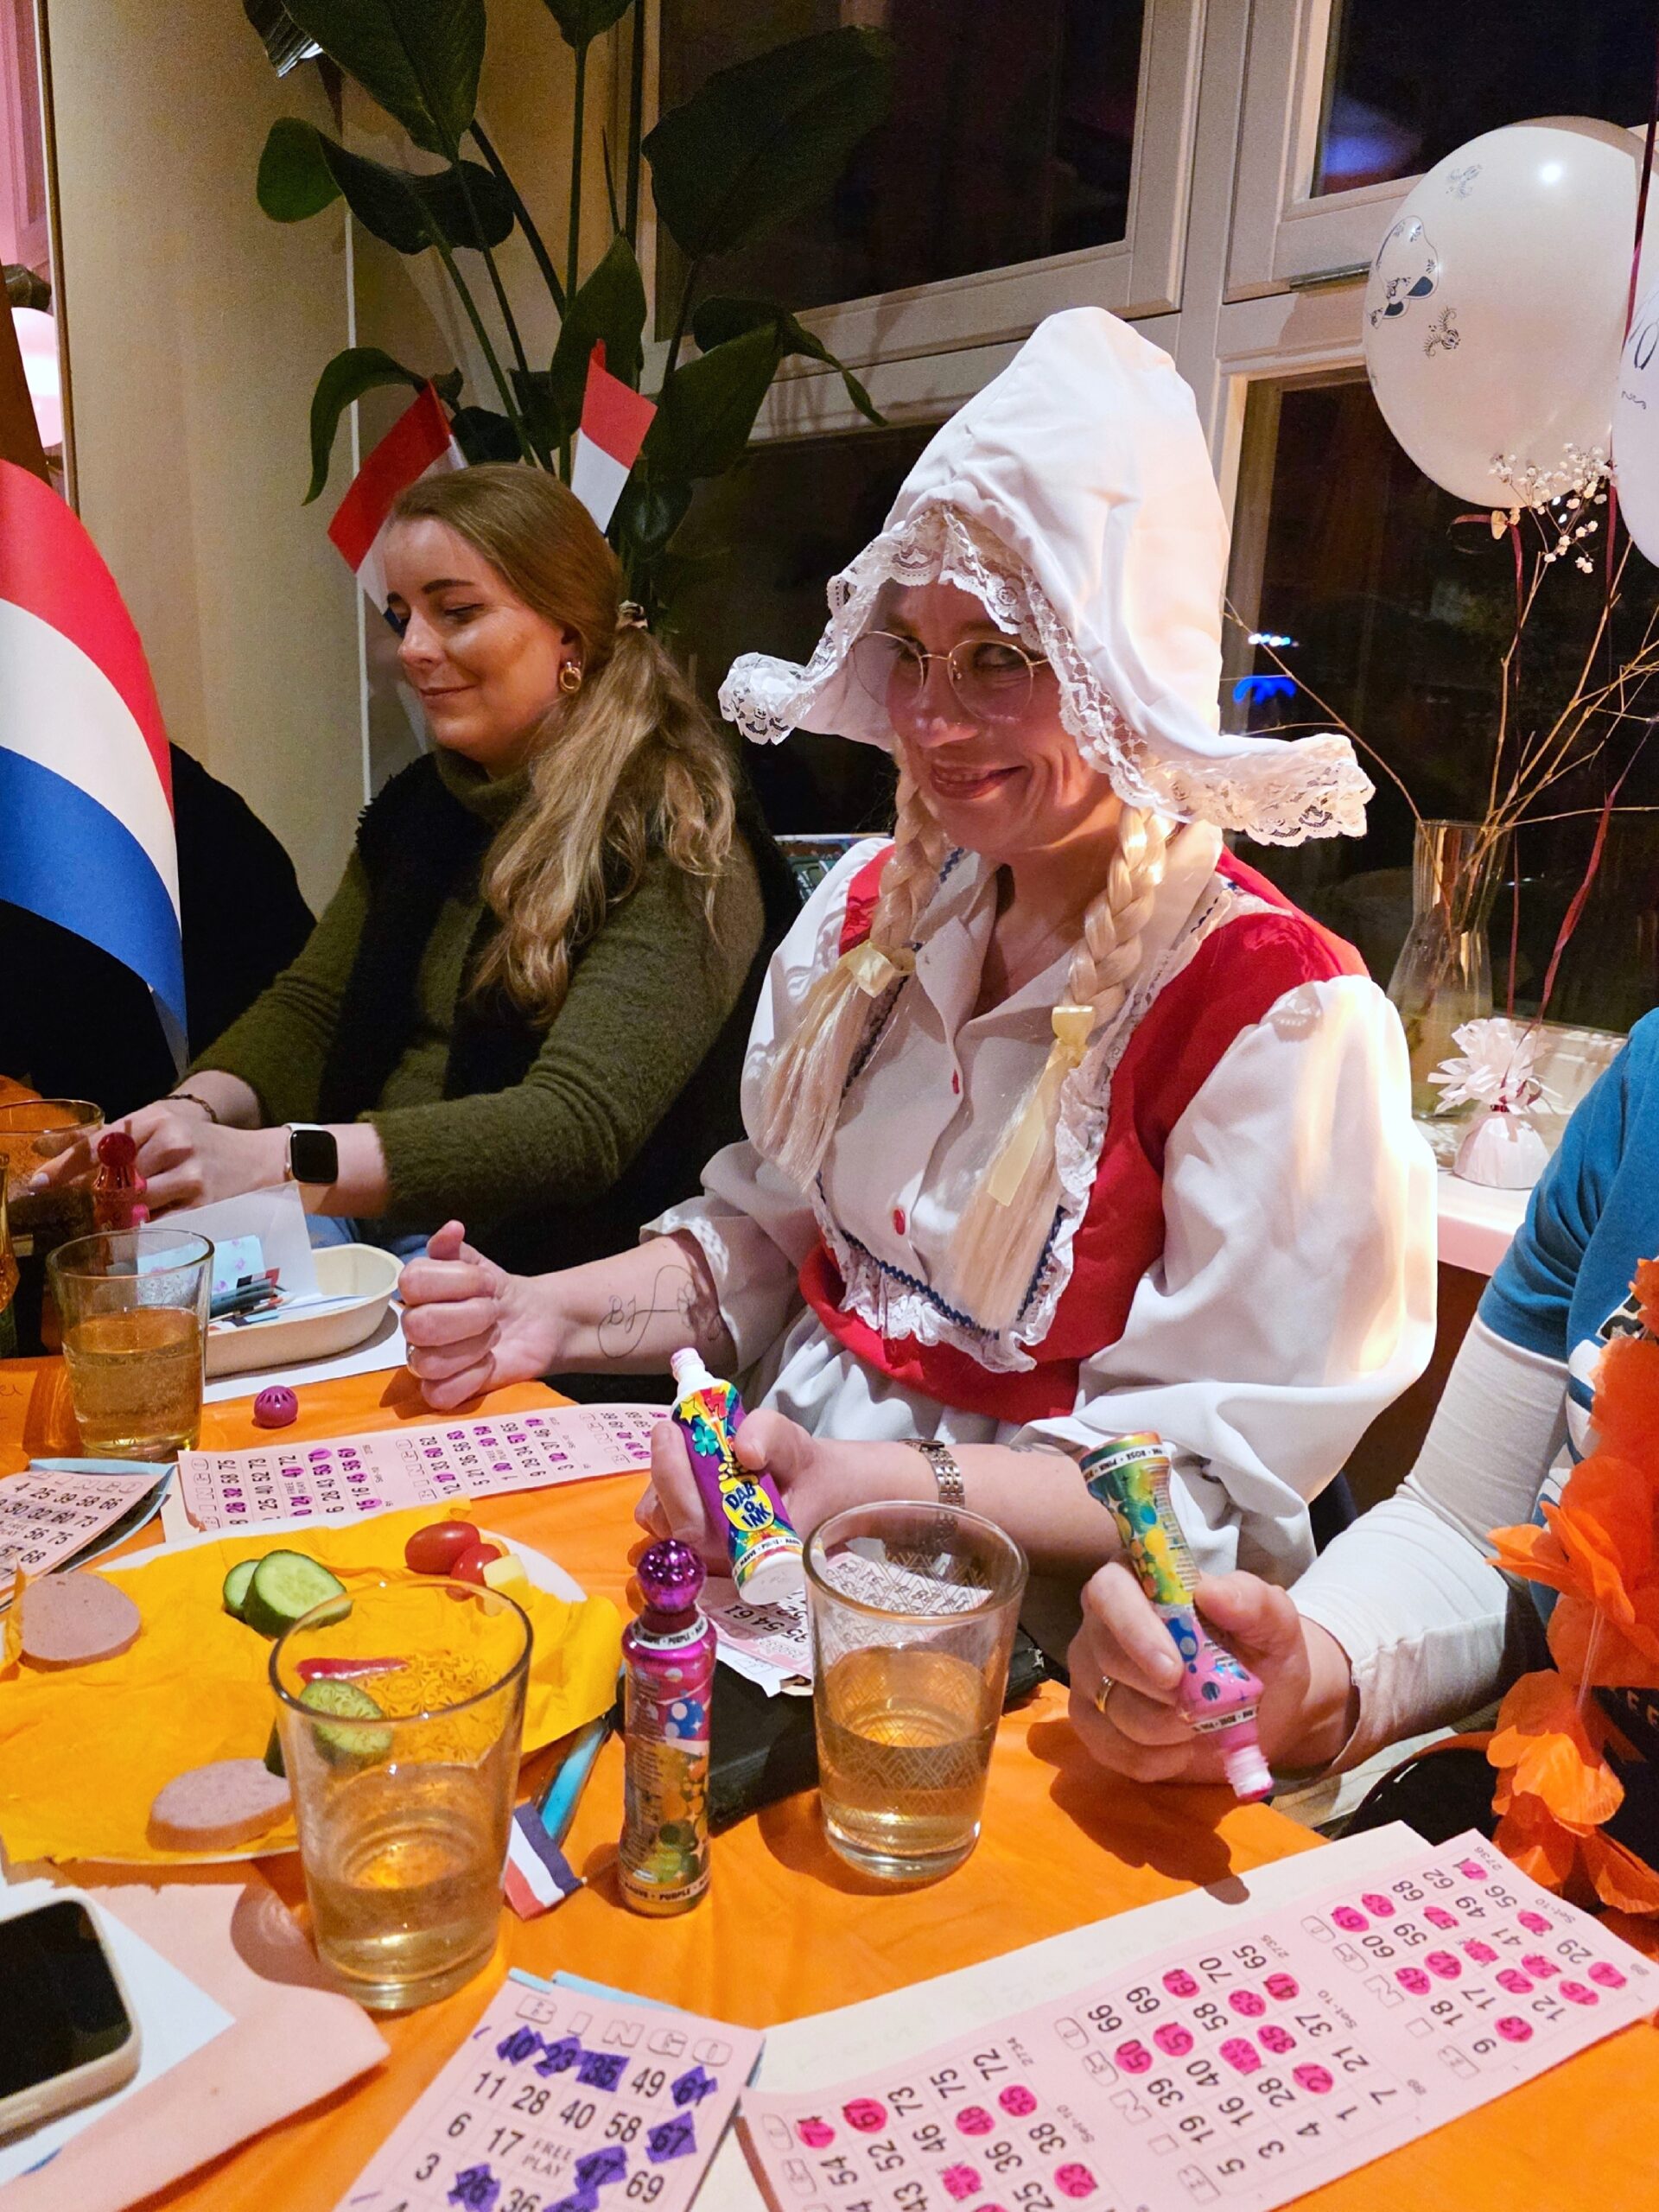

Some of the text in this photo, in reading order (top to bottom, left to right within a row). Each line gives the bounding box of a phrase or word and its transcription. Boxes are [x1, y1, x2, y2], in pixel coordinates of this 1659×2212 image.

[217, 1459, 236, 1470] 75
[248, 1458, 267, 1469] 73
[278, 1455, 297, 1465] 72
[251, 1471, 270, 1482] 52
[257, 1498, 278, 1510] 25
[725, 1481, 756, 1510] DAB
[741, 1503, 772, 1529] INK
[1392, 1880, 1424, 1902] 68
[1422, 1868, 1454, 1890] 62
[1455, 1896, 1486, 1918] 49
[1484, 1885, 1518, 1909] 56
[1361, 1935, 1395, 1958] 60
[1393, 1923, 1427, 1948] 59
[1491, 1928, 1522, 1946] 41
[1232, 1944, 1267, 1969] 65
[1556, 1939, 1593, 1965] 29
[1198, 1957, 1232, 1984] 70
[1126, 1986, 1160, 2014] 69
[1319, 1989, 1357, 2030] Set-10
[1430, 1999, 1463, 2026] 18
[1460, 1987, 1496, 2011] 17
[1531, 1995, 1566, 2022] 12
[1192, 2002, 1228, 2031] 58
[1294, 2013, 1332, 2037] 37
[515, 1994, 734, 2068] BINGO
[1472, 2037, 1497, 2054] 9
[973, 2048, 1008, 2081] 72
[1185, 2059, 1220, 2086] 40
[1332, 2046, 1370, 2073] 21
[632, 2067, 666, 2098] 49
[930, 2069, 966, 2099] 75
[1087, 2004, 1245, 2176] 5 19 39 50 66
[1257, 2077, 1296, 2107] 28
[1370, 2088, 1397, 2105] 7
[474, 2070, 692, 2155] 11 28 40 58 67
[887, 2086, 947, 2153] 46 73
[1218, 2096, 1255, 2126] 16
[1337, 2106, 1358, 2121] 1
[1029, 2122, 1066, 2155] 38
[1296, 2121, 1321, 2138] 4
[448, 2113, 473, 2138] 6
[487, 2127, 524, 2157] 17
[626, 2171, 665, 2204] 69
[533, 2140, 575, 2162] FREE
[868, 2139, 906, 2172] 52
[985, 2140, 1023, 2174] 36
[1258, 2140, 1284, 2159] 3
[415, 2152, 442, 2181] 3
[521, 2154, 565, 2177] PLAY
[820, 2155, 859, 2186] 54
[893, 2182, 930, 2212] 43
[1013, 2182, 1055, 2212] 25
